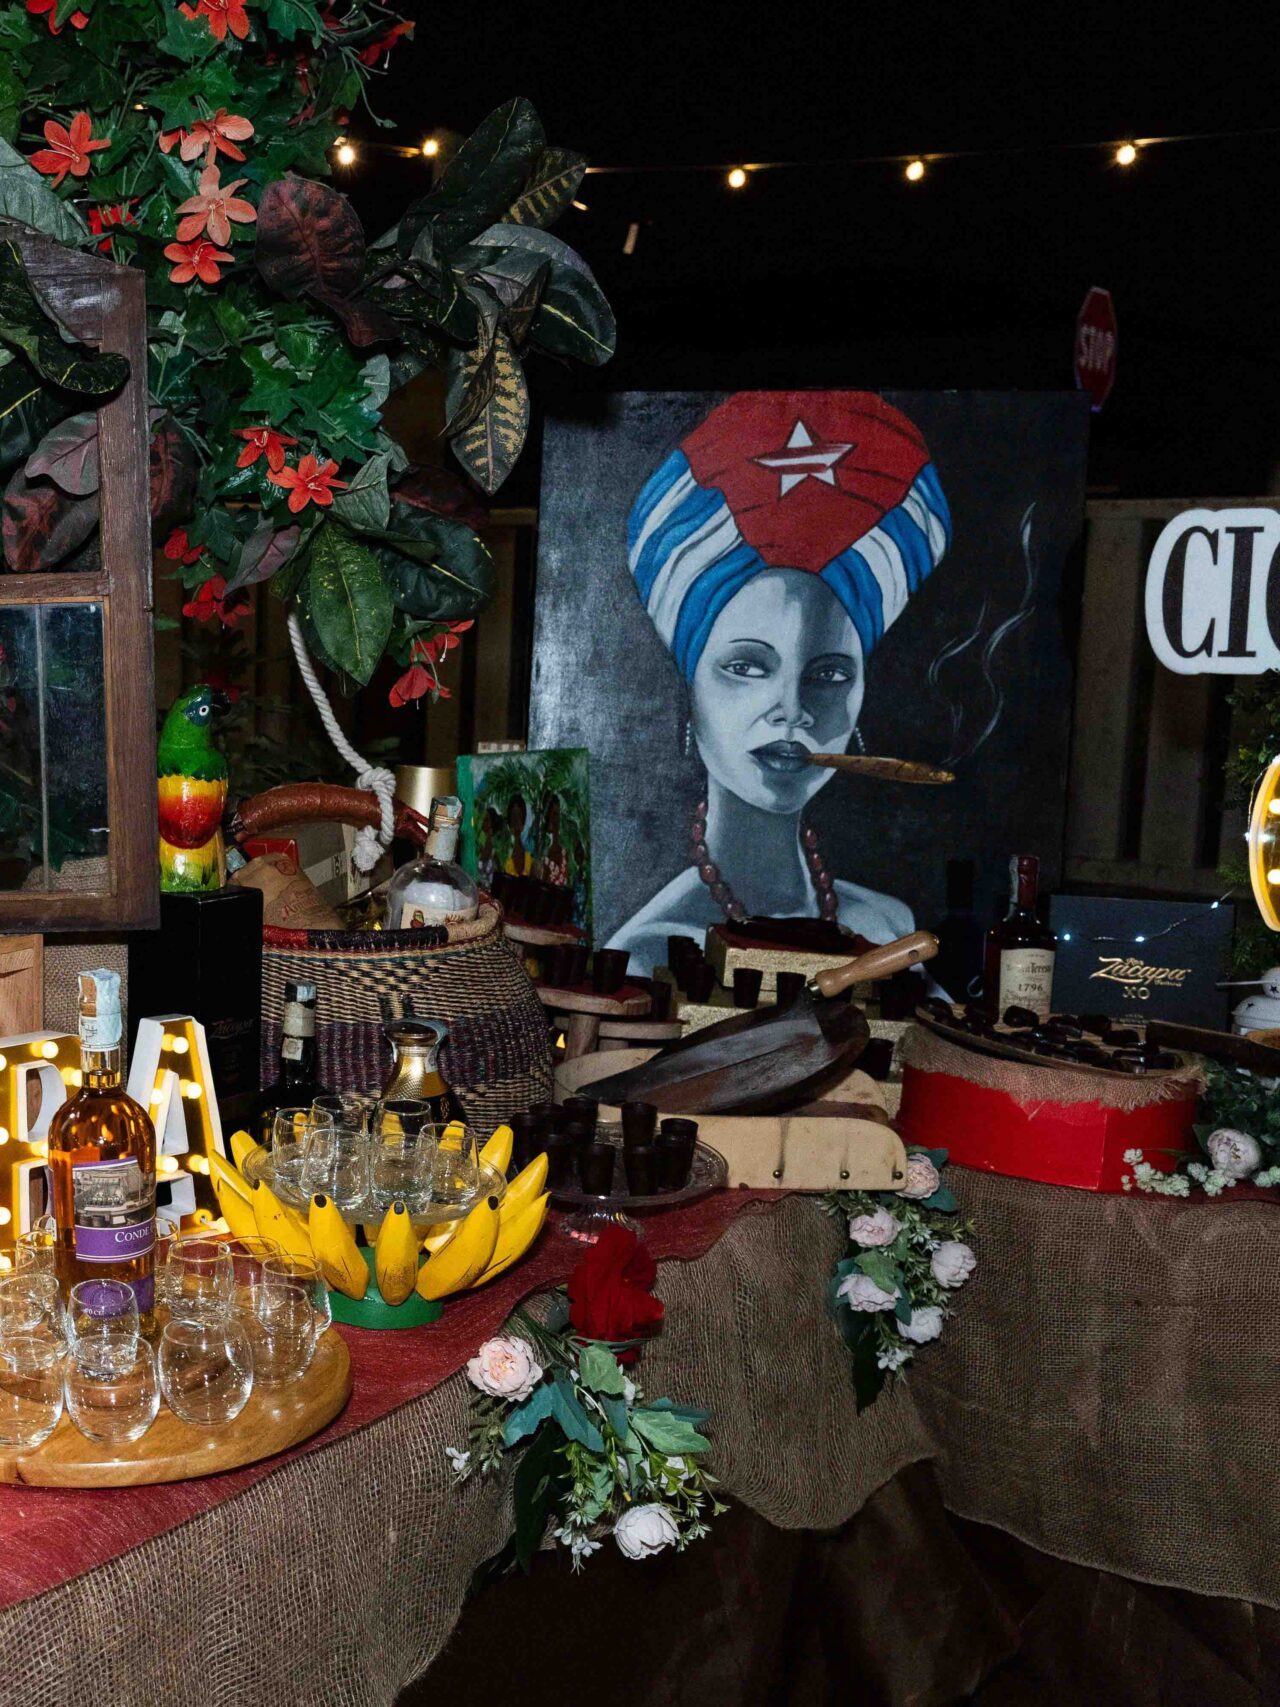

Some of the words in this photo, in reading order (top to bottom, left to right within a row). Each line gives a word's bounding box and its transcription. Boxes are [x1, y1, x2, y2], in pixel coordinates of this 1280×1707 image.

[1162, 525, 1280, 660] CI
[1017, 983, 1044, 993] 1796
[1121, 985, 1151, 1000] XO
